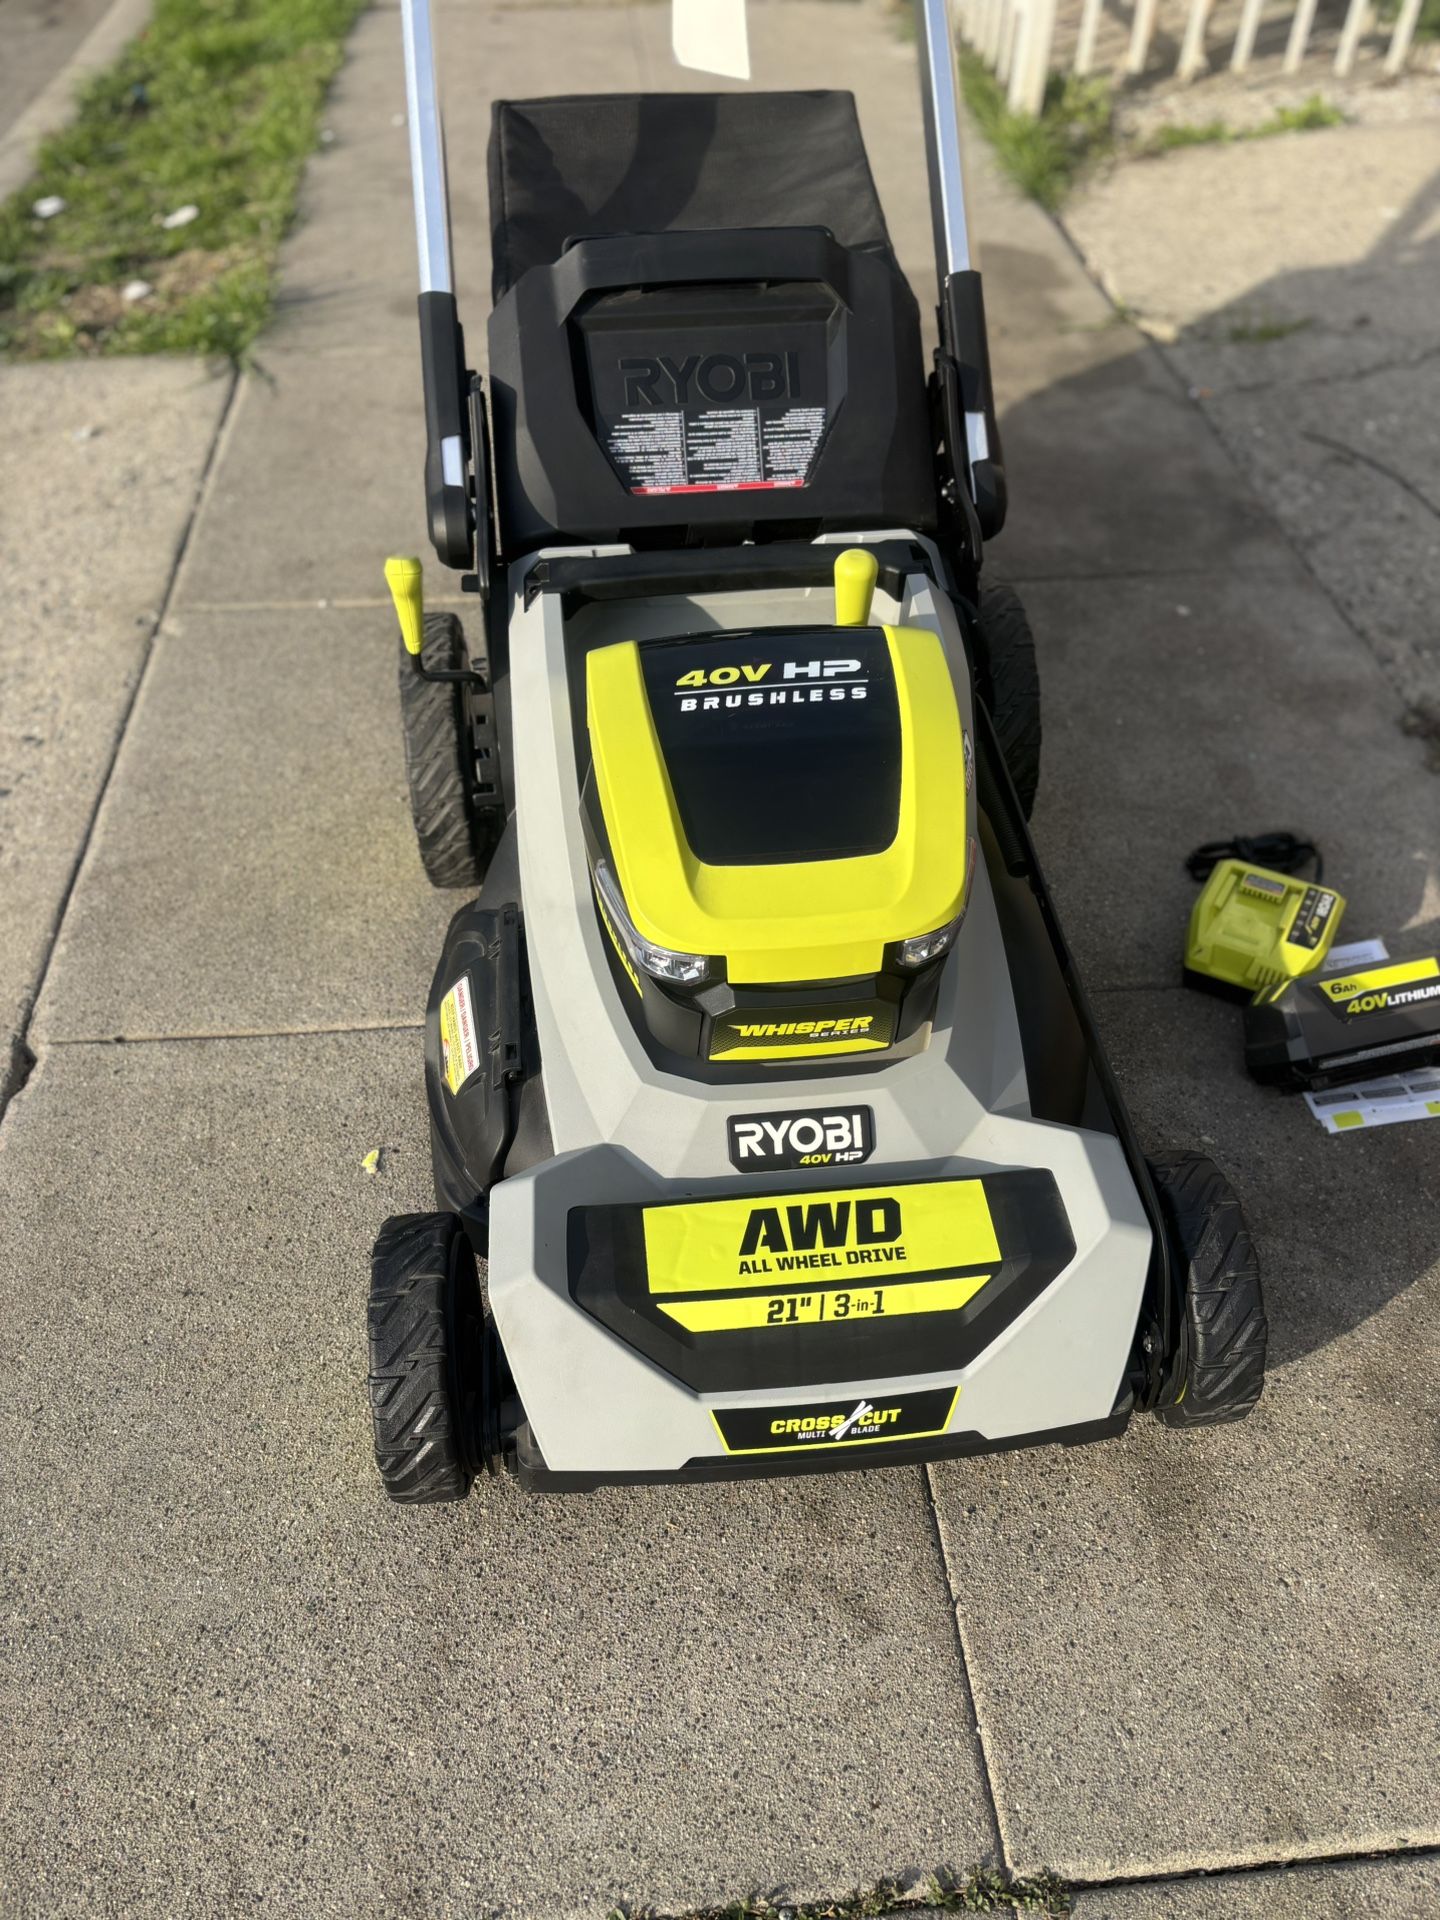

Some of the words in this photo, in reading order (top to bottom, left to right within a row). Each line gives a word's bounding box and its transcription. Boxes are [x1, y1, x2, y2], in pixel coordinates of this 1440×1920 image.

[618, 352, 800, 405] RYOBI
[676, 663, 772, 687] 40V
[783, 659, 862, 680] HP
[680, 687, 867, 712] BRUSHLESS
[1330, 983, 1357, 995] 6Ah
[729, 1016, 873, 1037] WHISPER
[809, 1028, 870, 1037] SERIES
[734, 1114, 863, 1158] RYOBI
[800, 1153, 832, 1164] 40V
[835, 1151, 863, 1162] HP
[739, 1197, 902, 1256] AWD
[739, 1260, 772, 1275] ALL
[776, 1253, 841, 1271] WHEEL
[846, 1246, 907, 1265] DRIVE
[767, 1296, 812, 1323] 21"
[833, 1290, 885, 1318] 3-in-1
[770, 1414, 846, 1434] CROSS
[858, 1408, 902, 1426] CUT
[797, 1430, 826, 1440] MULTI
[851, 1425, 881, 1435] BLADE
